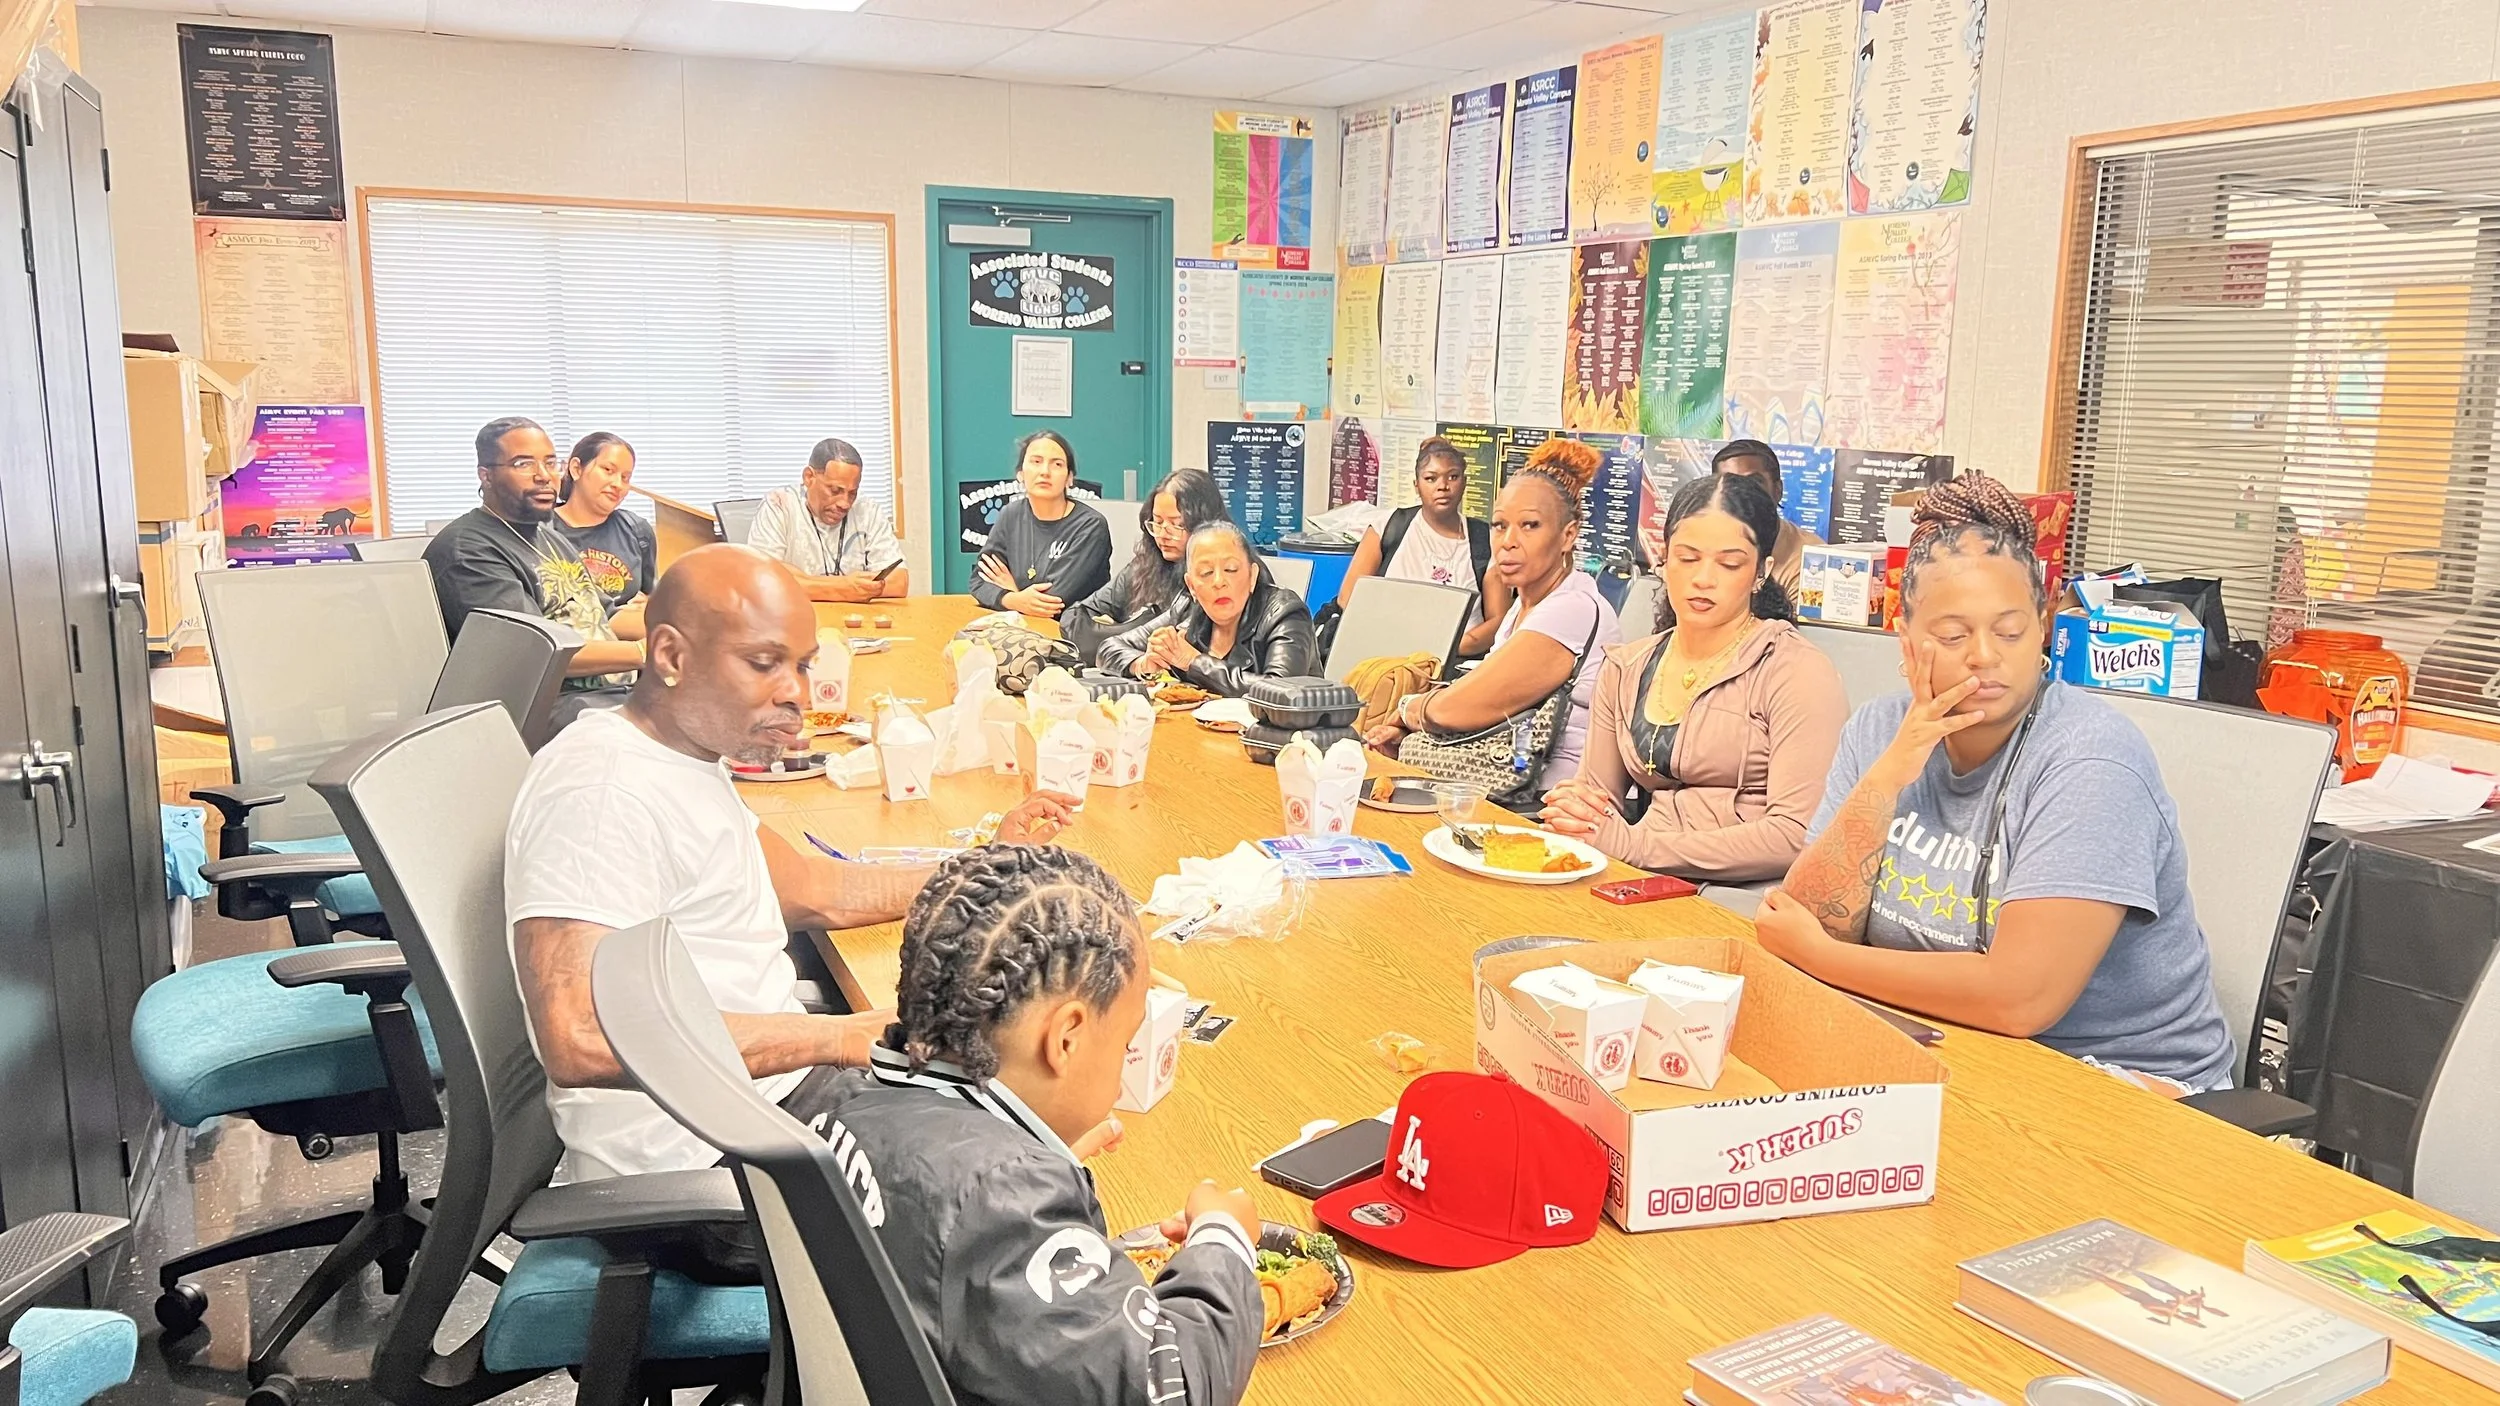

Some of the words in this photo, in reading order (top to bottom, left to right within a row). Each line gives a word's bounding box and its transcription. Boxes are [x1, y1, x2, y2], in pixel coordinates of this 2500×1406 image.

[1531, 76, 1556, 94] ASRCC
[1549, 89, 1572, 101] Campus
[1466, 94, 1487, 109] ASRCC
[970, 252, 1049, 280] Associated
[1050, 254, 1113, 287] Students
[1021, 268, 1061, 284] MVC
[970, 300, 1022, 327] MORENO
[1023, 315, 1064, 329] VALLEY
[1064, 304, 1113, 329] COLLEGE
[1021, 300, 1061, 315] LIONS
[1213, 374, 1229, 383] EXIT
[960, 480, 1026, 510] Associat
[587, 547, 633, 582] HISTORY
[2091, 642, 2161, 674] Welch's
[1880, 908, 1897, 922] not
[1549, 978, 1577, 998] Yummy
[1666, 974, 1707, 992] Yummy
[1553, 1030, 1577, 1039] Thank
[1640, 1023, 1665, 1041] ummy
[1682, 1023, 1711, 1035] Thank
[1534, 1063, 1547, 1092] K
[1544, 1067, 1590, 1106] SUPER
[1757, 1107, 1863, 1163] SUPER
[1396, 1115, 1429, 1191] LA
[1726, 1142, 1755, 1175] K
[2055, 1229, 2116, 1255] NATALIE
[1996, 1249, 2058, 1272] BASZILE
